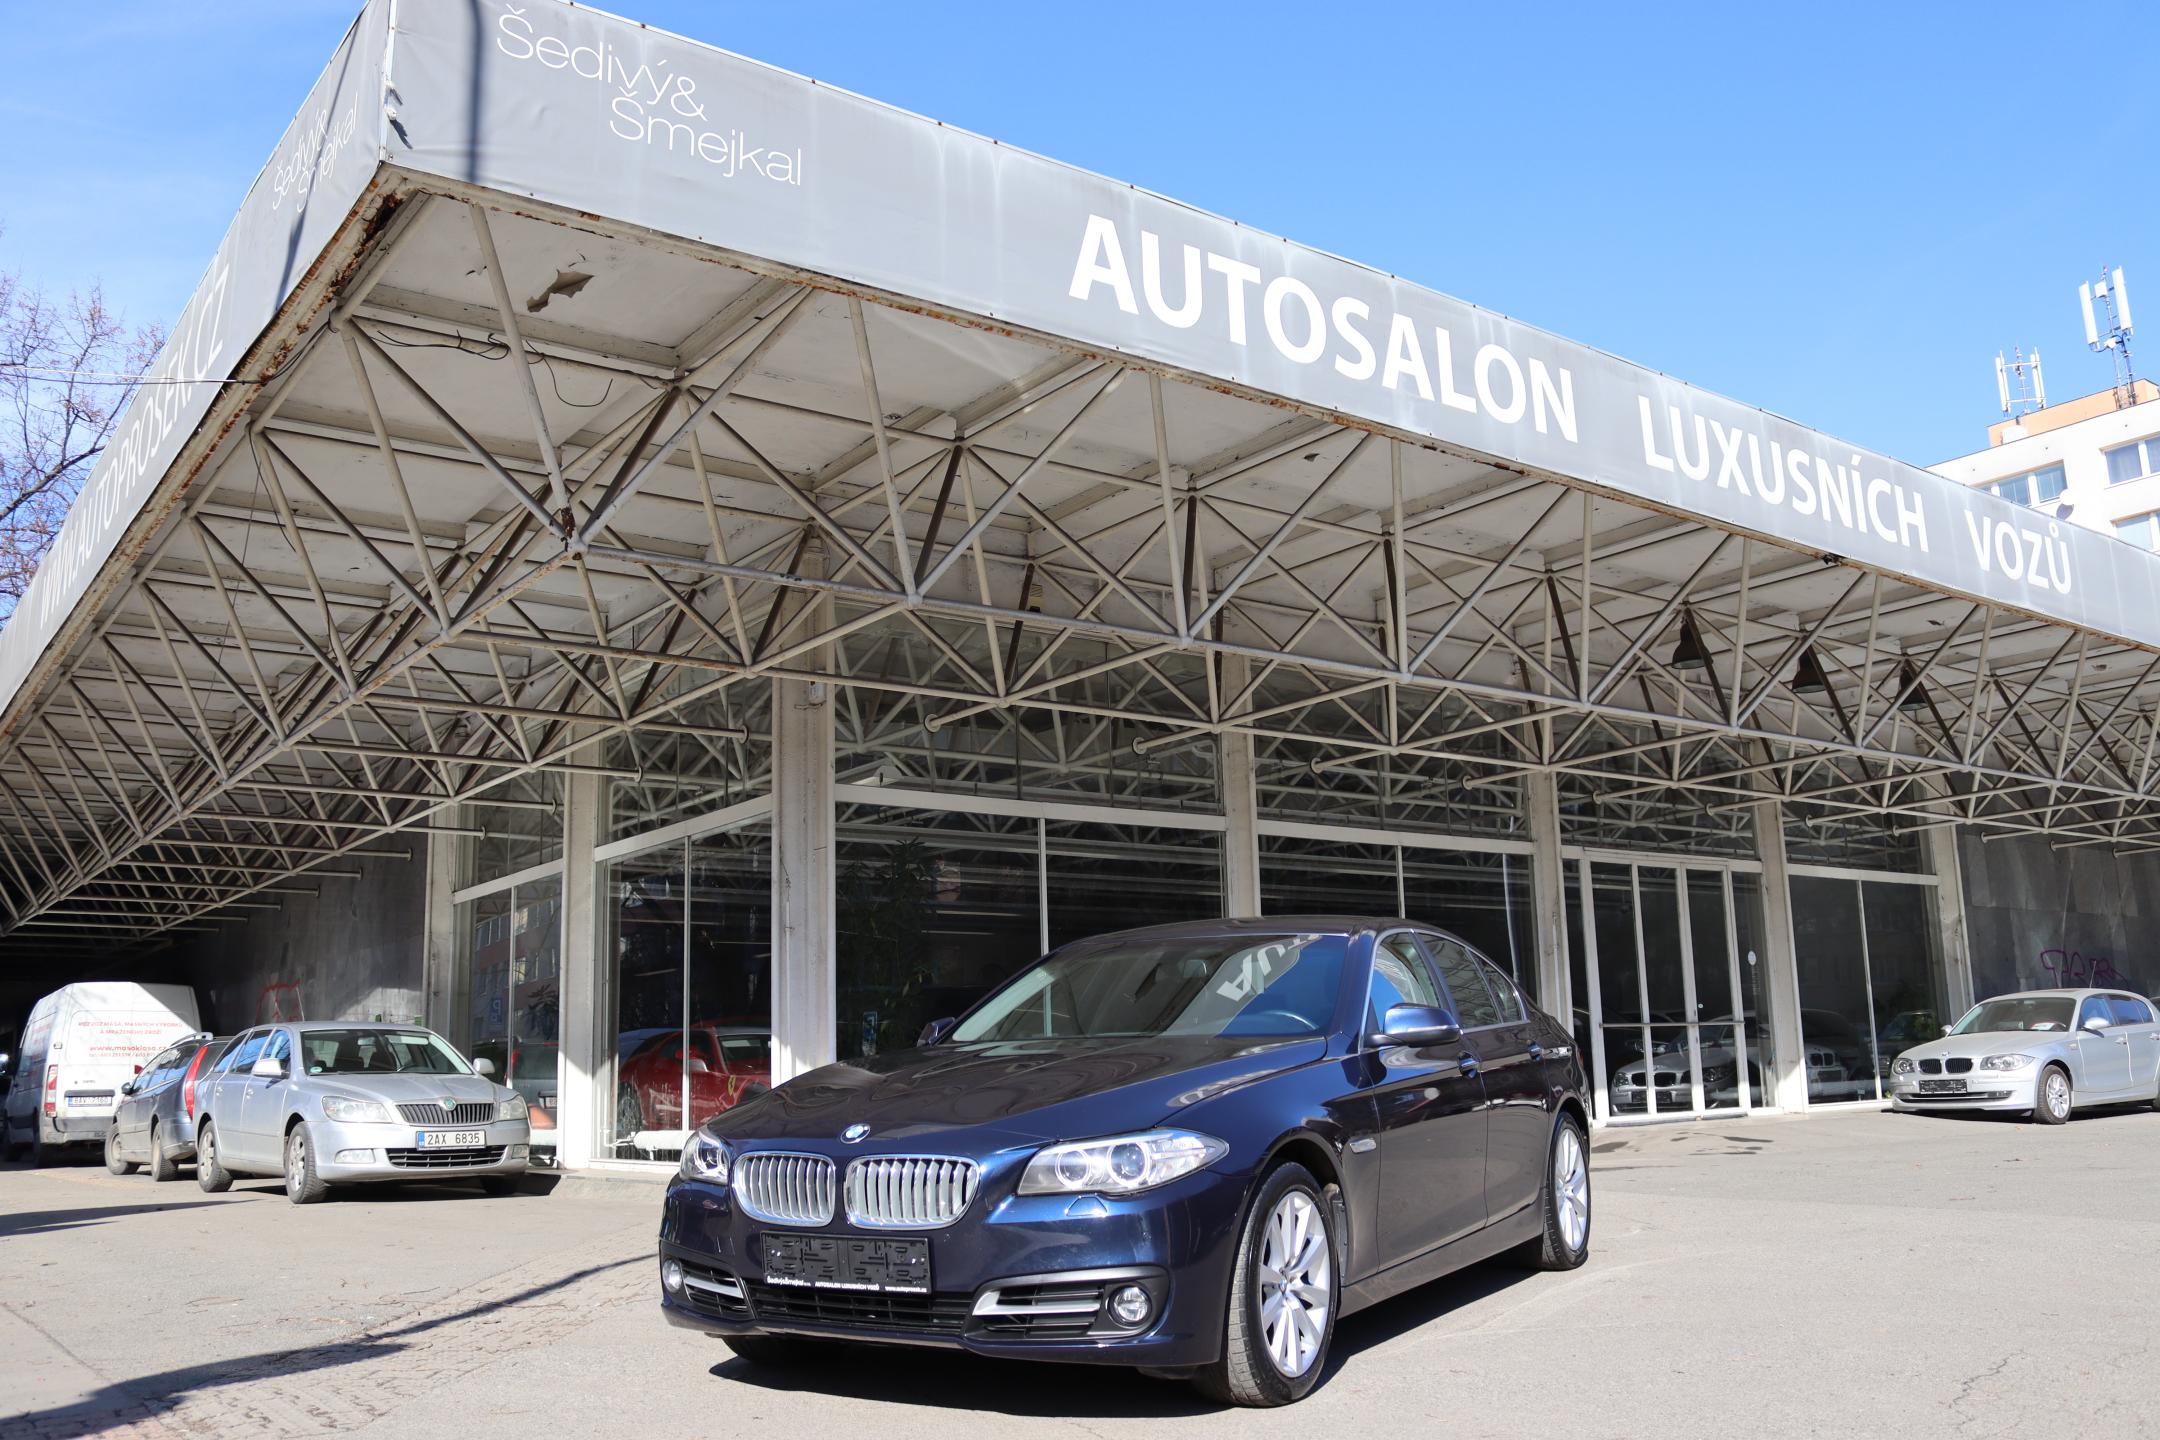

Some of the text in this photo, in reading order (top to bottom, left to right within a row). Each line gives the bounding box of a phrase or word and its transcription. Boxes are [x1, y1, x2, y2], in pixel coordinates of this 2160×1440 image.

[497, 3, 708, 121] Šedivý&
[609, 86, 801, 186] Šmejkal
[1068, 213, 2072, 595] AUTOSALON LUXUSNÍCH VOZŮ
[427, 1132, 480, 1145] 2AX 6835
